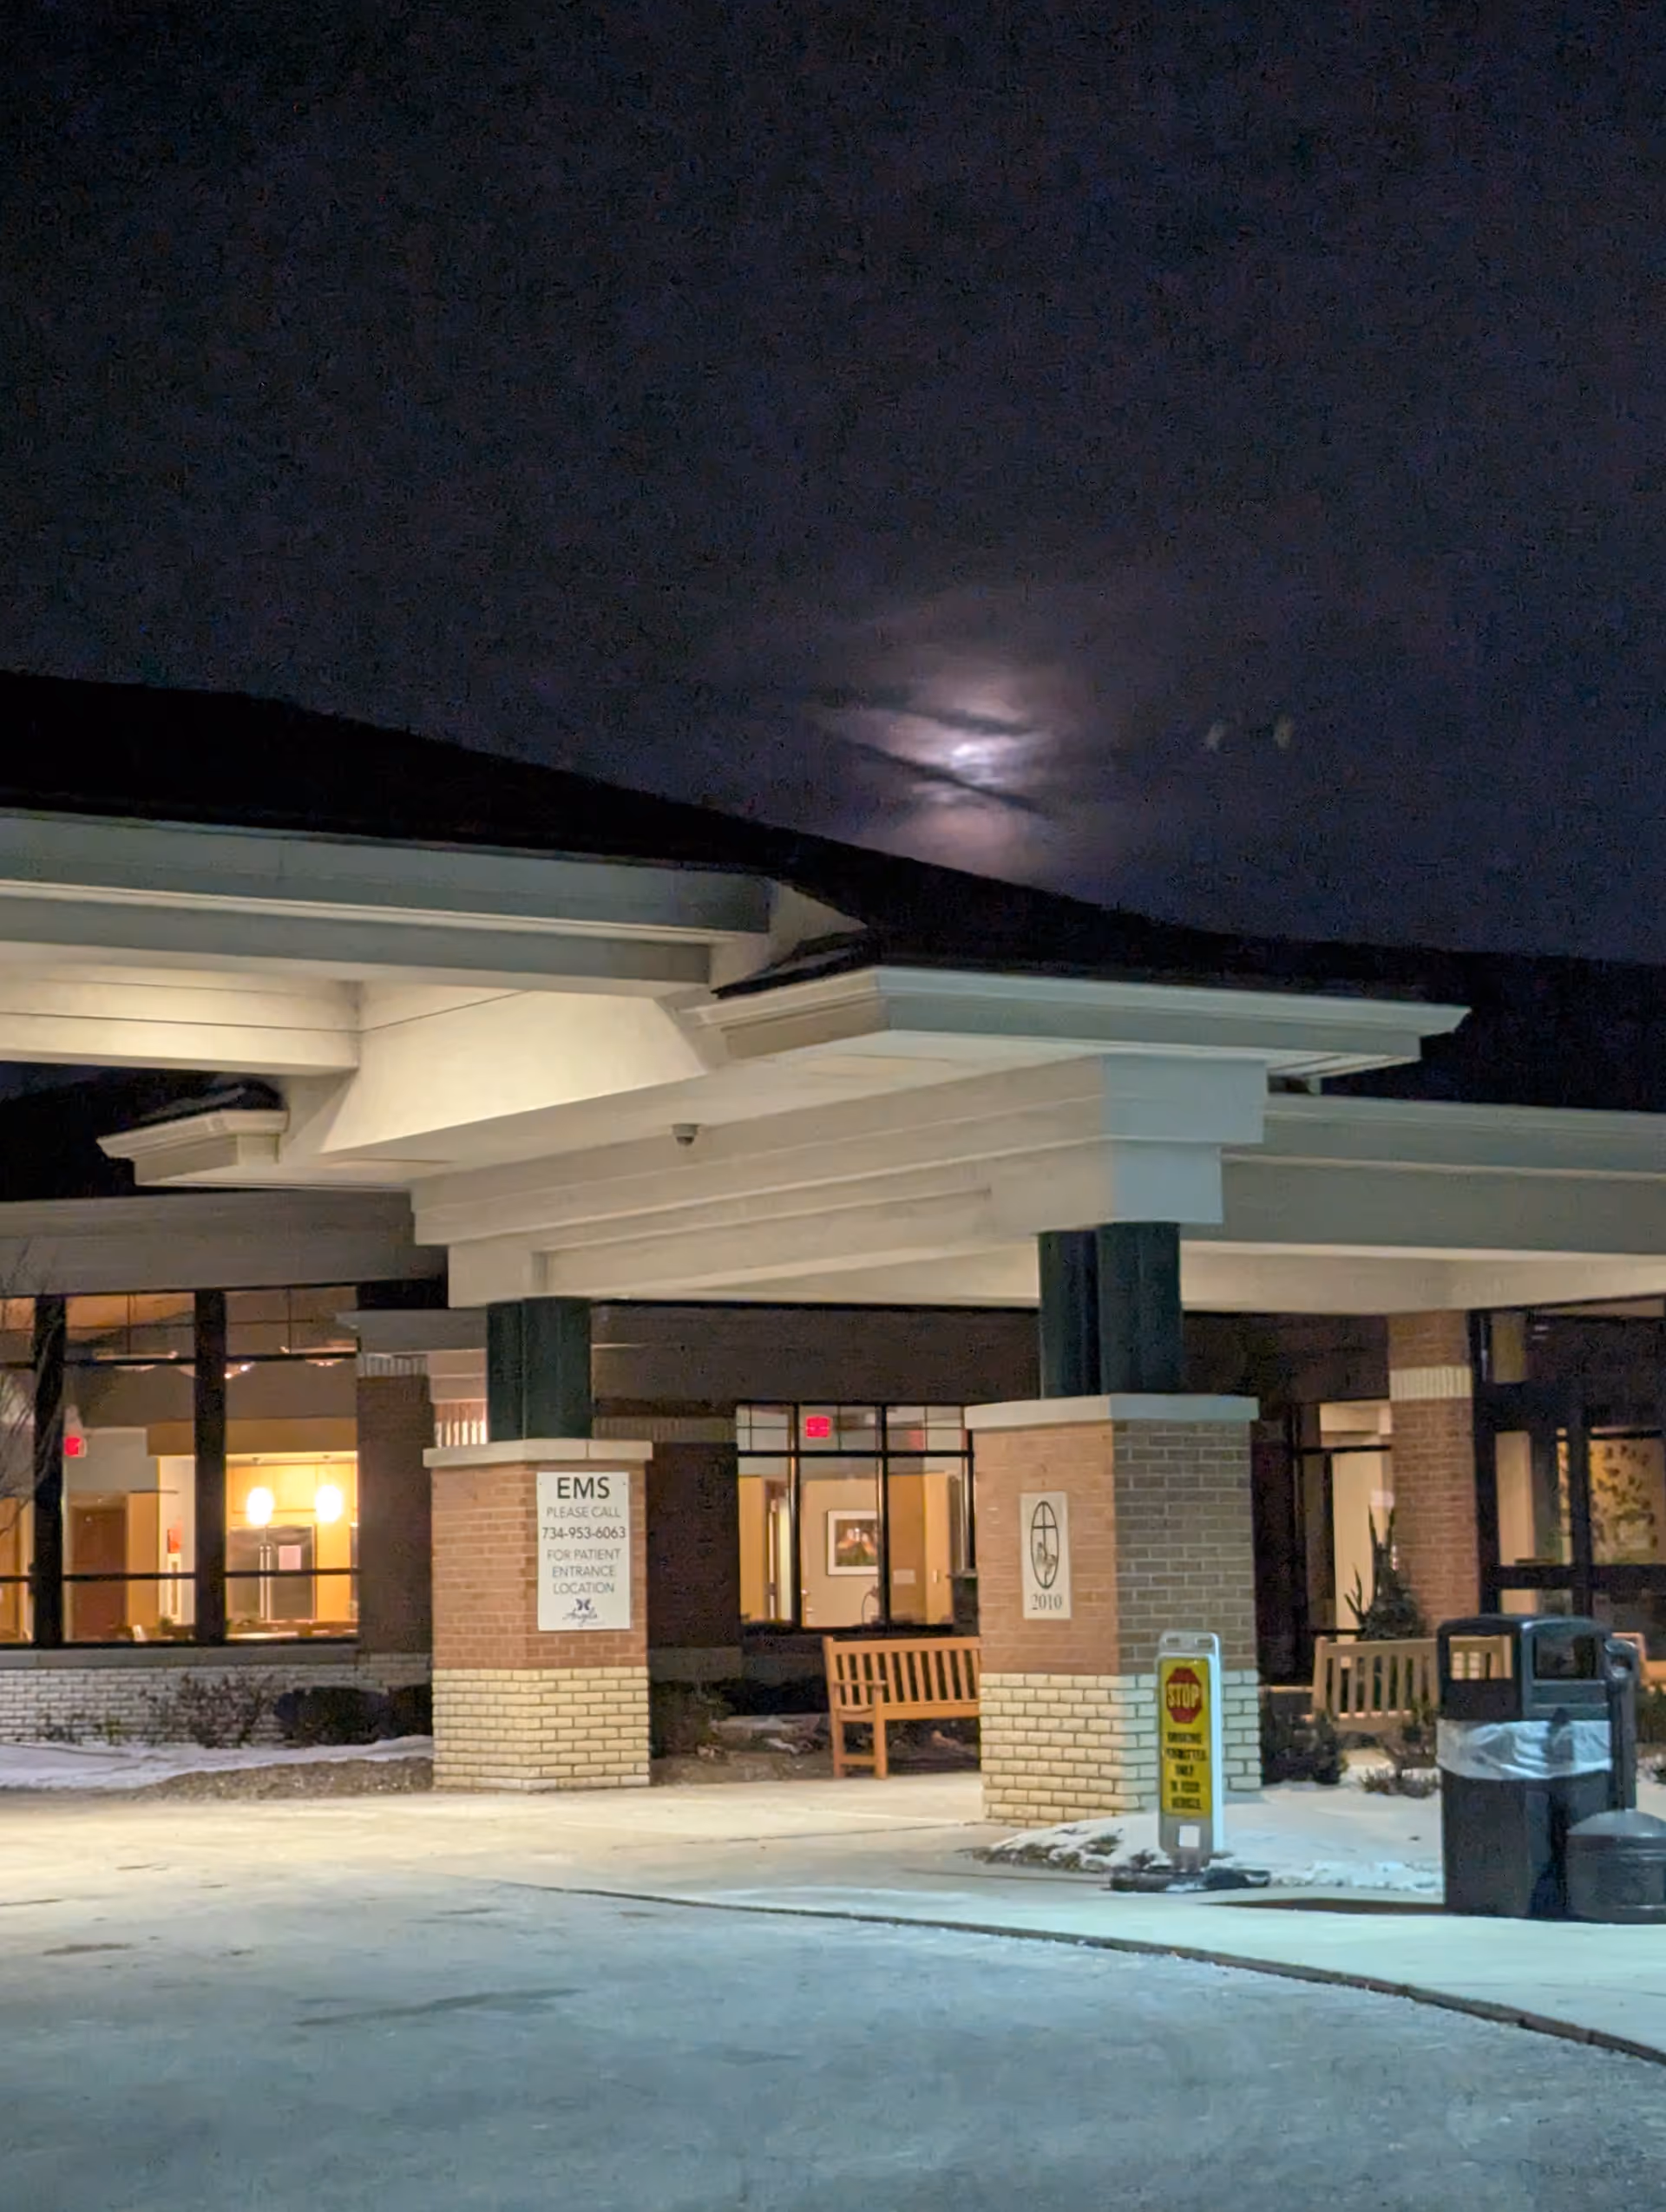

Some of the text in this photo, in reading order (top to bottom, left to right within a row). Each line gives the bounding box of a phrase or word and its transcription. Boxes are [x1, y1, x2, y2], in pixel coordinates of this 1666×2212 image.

[556, 1476, 610, 1499] EMS
[546, 1506, 621, 1519] PLEASE CALL
[541, 1526, 626, 1540] 734-953-6063
[547, 1548, 621, 1561] FOR PATIENT
[552, 1565, 615, 1577] ENTRANCE
[553, 1582, 614, 1594] LOCATION
[1031, 1593, 1062, 1611] 2010
[1167, 1683, 1199, 1709] STOP
